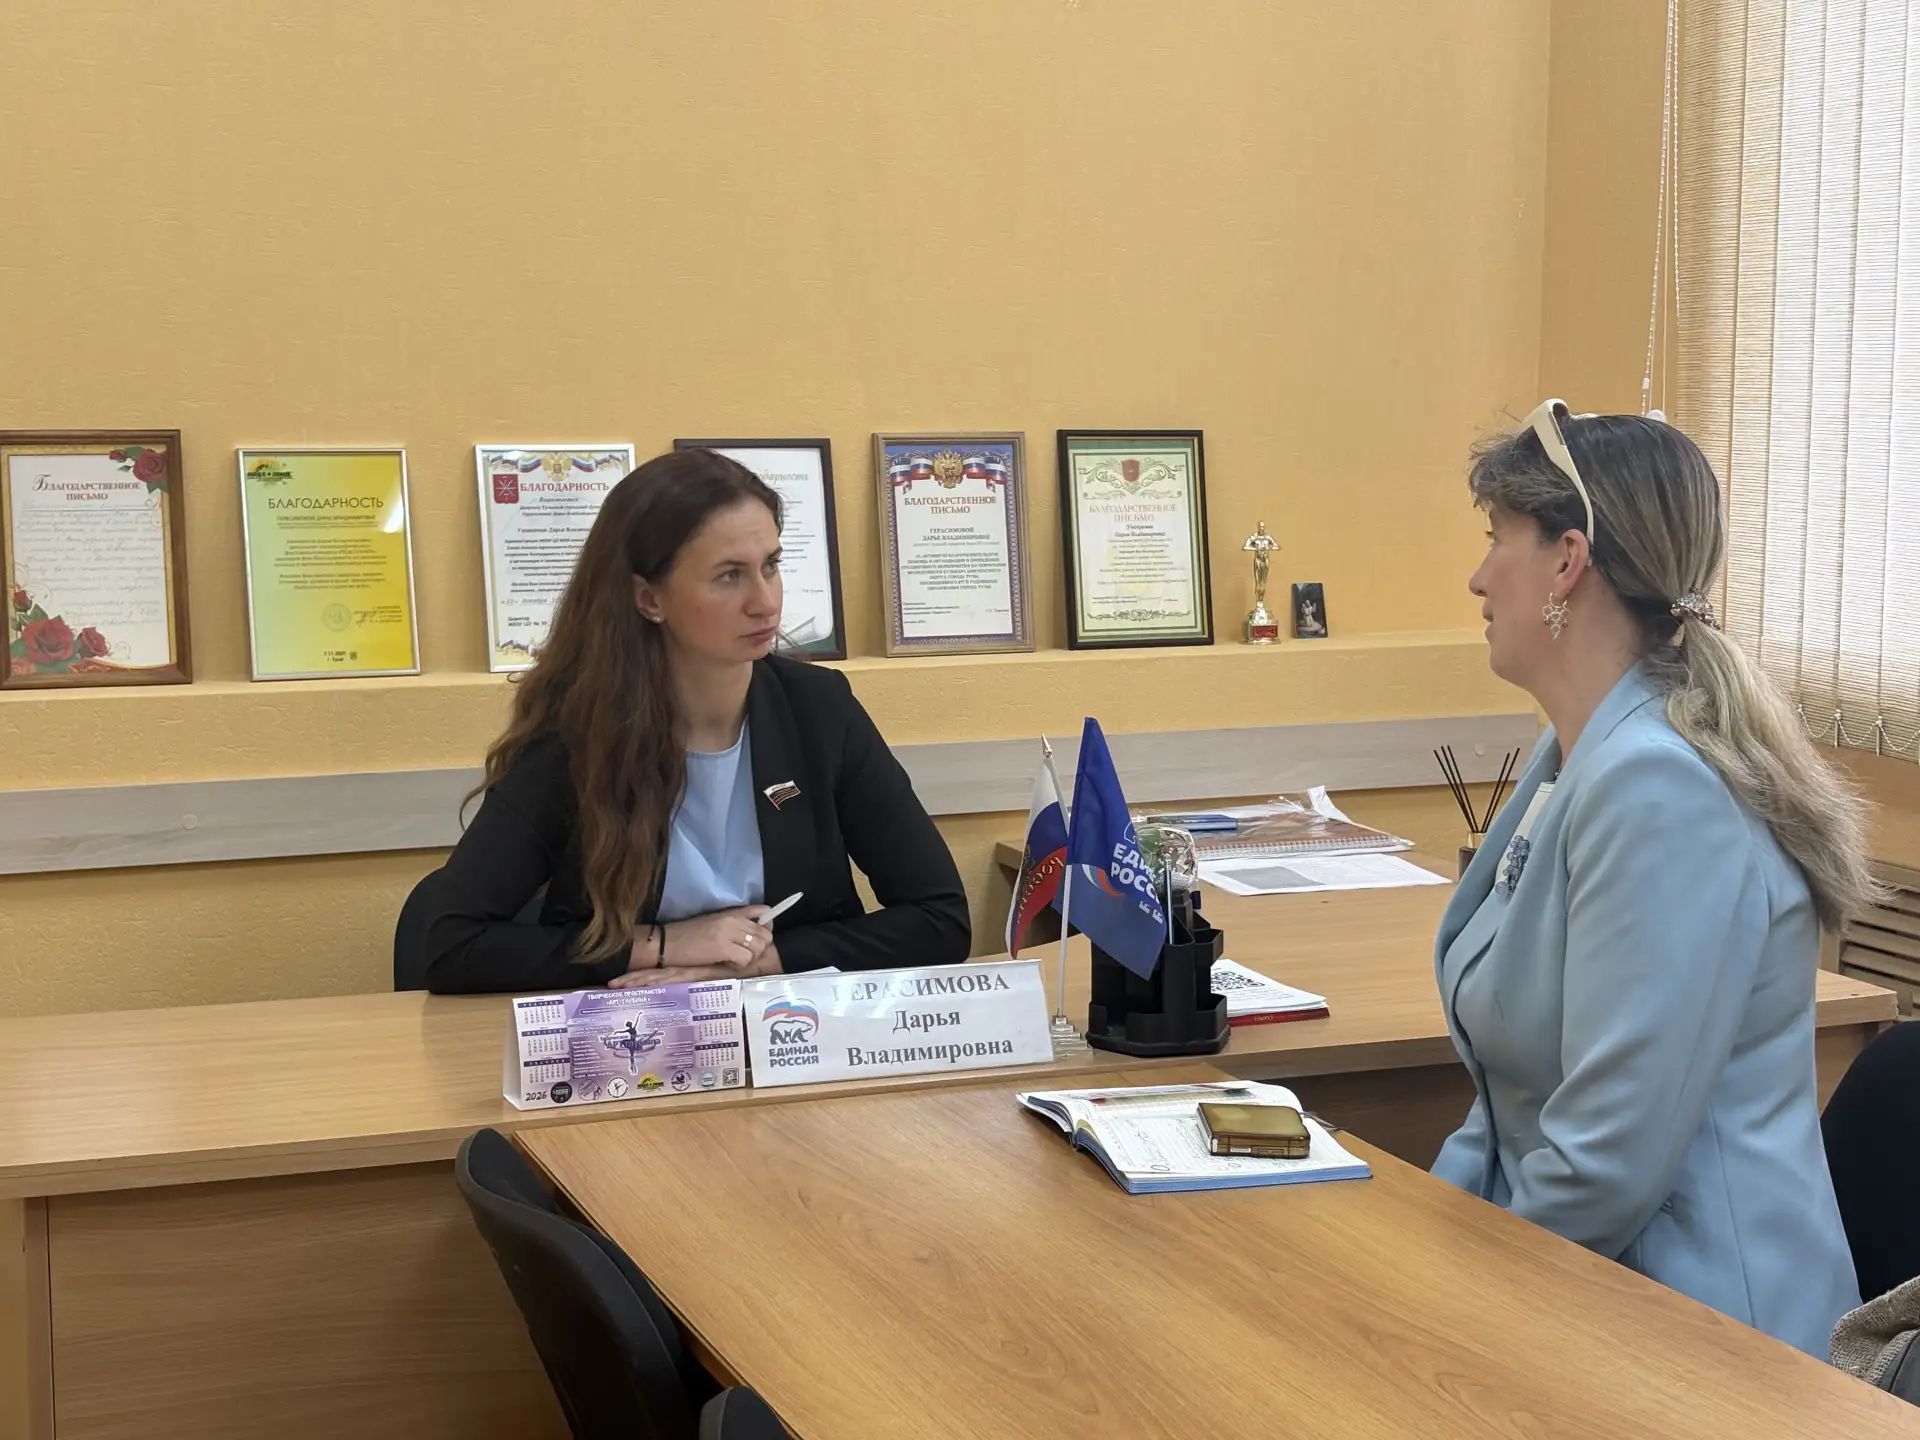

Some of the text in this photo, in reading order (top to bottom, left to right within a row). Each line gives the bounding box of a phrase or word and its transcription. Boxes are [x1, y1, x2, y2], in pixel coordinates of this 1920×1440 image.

[520, 483, 609, 492] БЛАГОДАРНОСТЬ
[268, 497, 384, 509] БЛАГОДАРНОСТЬ
[905, 496, 996, 505] БЛАГОДАРСТВЕННОЕ
[931, 506, 970, 514] ПИСЬМО
[1089, 504, 1177, 513] БЛАГОДАРСТВЕННОЕ
[1114, 514, 1154, 522] ПИСЬМО
[587, 988, 666, 1000] ТВОРЧЕСКОЕ ПРОСТРАНСТВО
[831, 974, 1010, 1002] ГЕРАСИМОВА
[892, 1010, 961, 1035] Дарья
[769, 1045, 818, 1057] ЕДИНАЯ
[846, 1038, 1013, 1067] Владимировна
[770, 1055, 820, 1067] РОССИЯ
[525, 1091, 548, 1101] 2026
